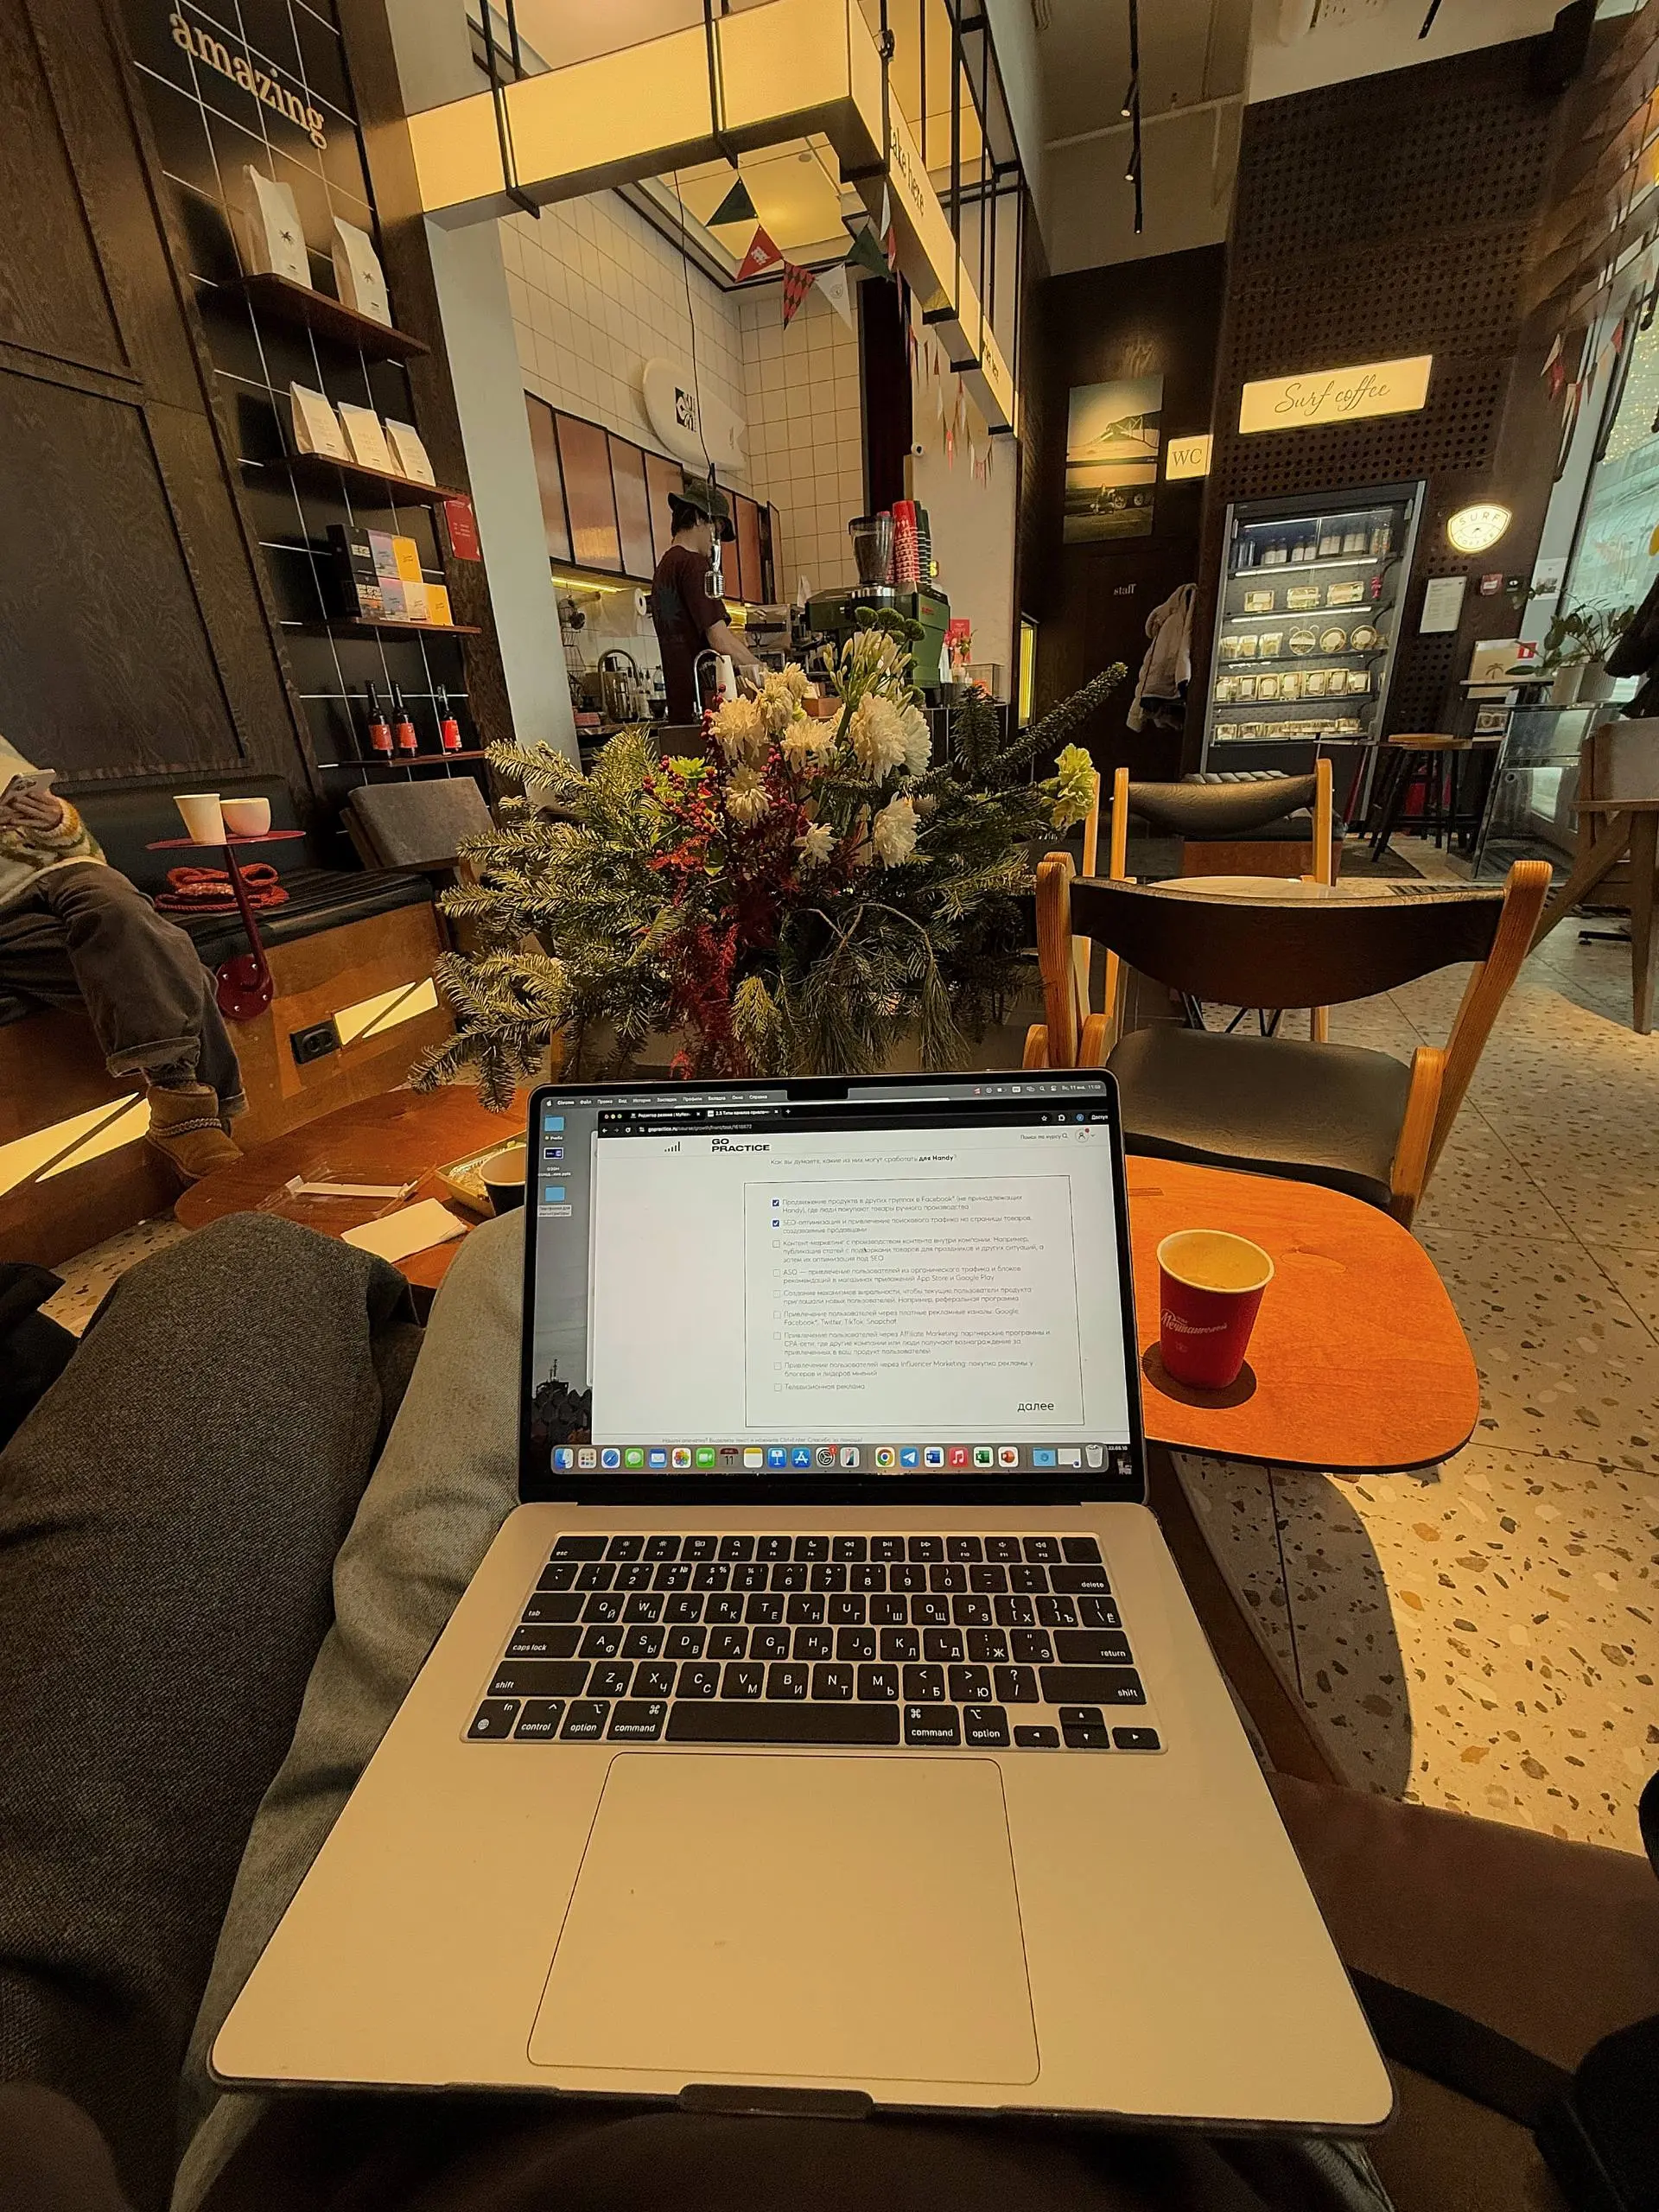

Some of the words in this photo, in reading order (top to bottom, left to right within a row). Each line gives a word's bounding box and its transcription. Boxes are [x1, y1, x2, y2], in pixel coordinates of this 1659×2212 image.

[169, 13, 327, 149] amazing
[907, 152, 925, 217] here
[1274, 380, 1335, 416] Surf
[1335, 374, 1390, 411] coffee
[1172, 448, 1202, 467] WC
[1459, 512, 1501, 525] SURF
[1114, 583, 1137, 595] staff
[1017, 1402, 1055, 1413] далее
[725, 1455, 734, 1465] 11
[599, 1602, 607, 1611] Q
[639, 1602, 650, 1611] W
[680, 1602, 688, 1611] E
[720, 1603, 728, 1611] R
[761, 1603, 769, 1611] T
[802, 1603, 810, 1612] Y
[842, 1604, 851, 1612] U
[925, 1605, 934, 1613] O
[968, 1605, 976, 1613] P
[607, 1610, 615, 1618] Й
[648, 1611, 656, 1619] Ц
[690, 1611, 697, 1619] У
[893, 1612, 902, 1621] Ш
[935, 1612, 945, 1621] Щ
[1023, 1613, 1032, 1622] Х
[1064, 1614, 1074, 1623] Ъ
[1107, 1613, 1116, 1623] Ё
[596, 1636, 605, 1645] A
[639, 1636, 647, 1645] S
[682, 1637, 690, 1645] D
[724, 1637, 732, 1646] F
[766, 1637, 775, 1646] G
[809, 1637, 817, 1647] H
[853, 1638, 859, 1648] J
[896, 1638, 904, 1648] K
[940, 1639, 947, 1649] L
[606, 1644, 614, 1653] Ф
[647, 1645, 657, 1654] Ы
[777, 1646, 785, 1655] П
[822, 1647, 829, 1656] Р
[908, 1648, 916, 1656] Л
[951, 1649, 960, 1657] Д
[994, 1648, 1005, 1657] Ж
[606, 1673, 615, 1682] Z
[650, 1673, 659, 1683] X
[694, 1674, 703, 1683] C
[739, 1674, 748, 1683] V
[784, 1675, 792, 1685] B
[828, 1675, 837, 1685] N
[873, 1675, 883, 1686] M
[615, 1682, 623, 1692] Я
[660, 1683, 667, 1693] Ч
[703, 1684, 712, 1694] С
[747, 1685, 758, 1694] М
[794, 1685, 803, 1694] И
[841, 1686, 849, 1695] Т
[887, 1687, 895, 1695] Ь
[933, 1687, 940, 1696] Б
[977, 1688, 989, 1697] Ю
[570, 1723, 597, 1732] option
[614, 1724, 655, 1732] command
[972, 1729, 1001, 1739] option
